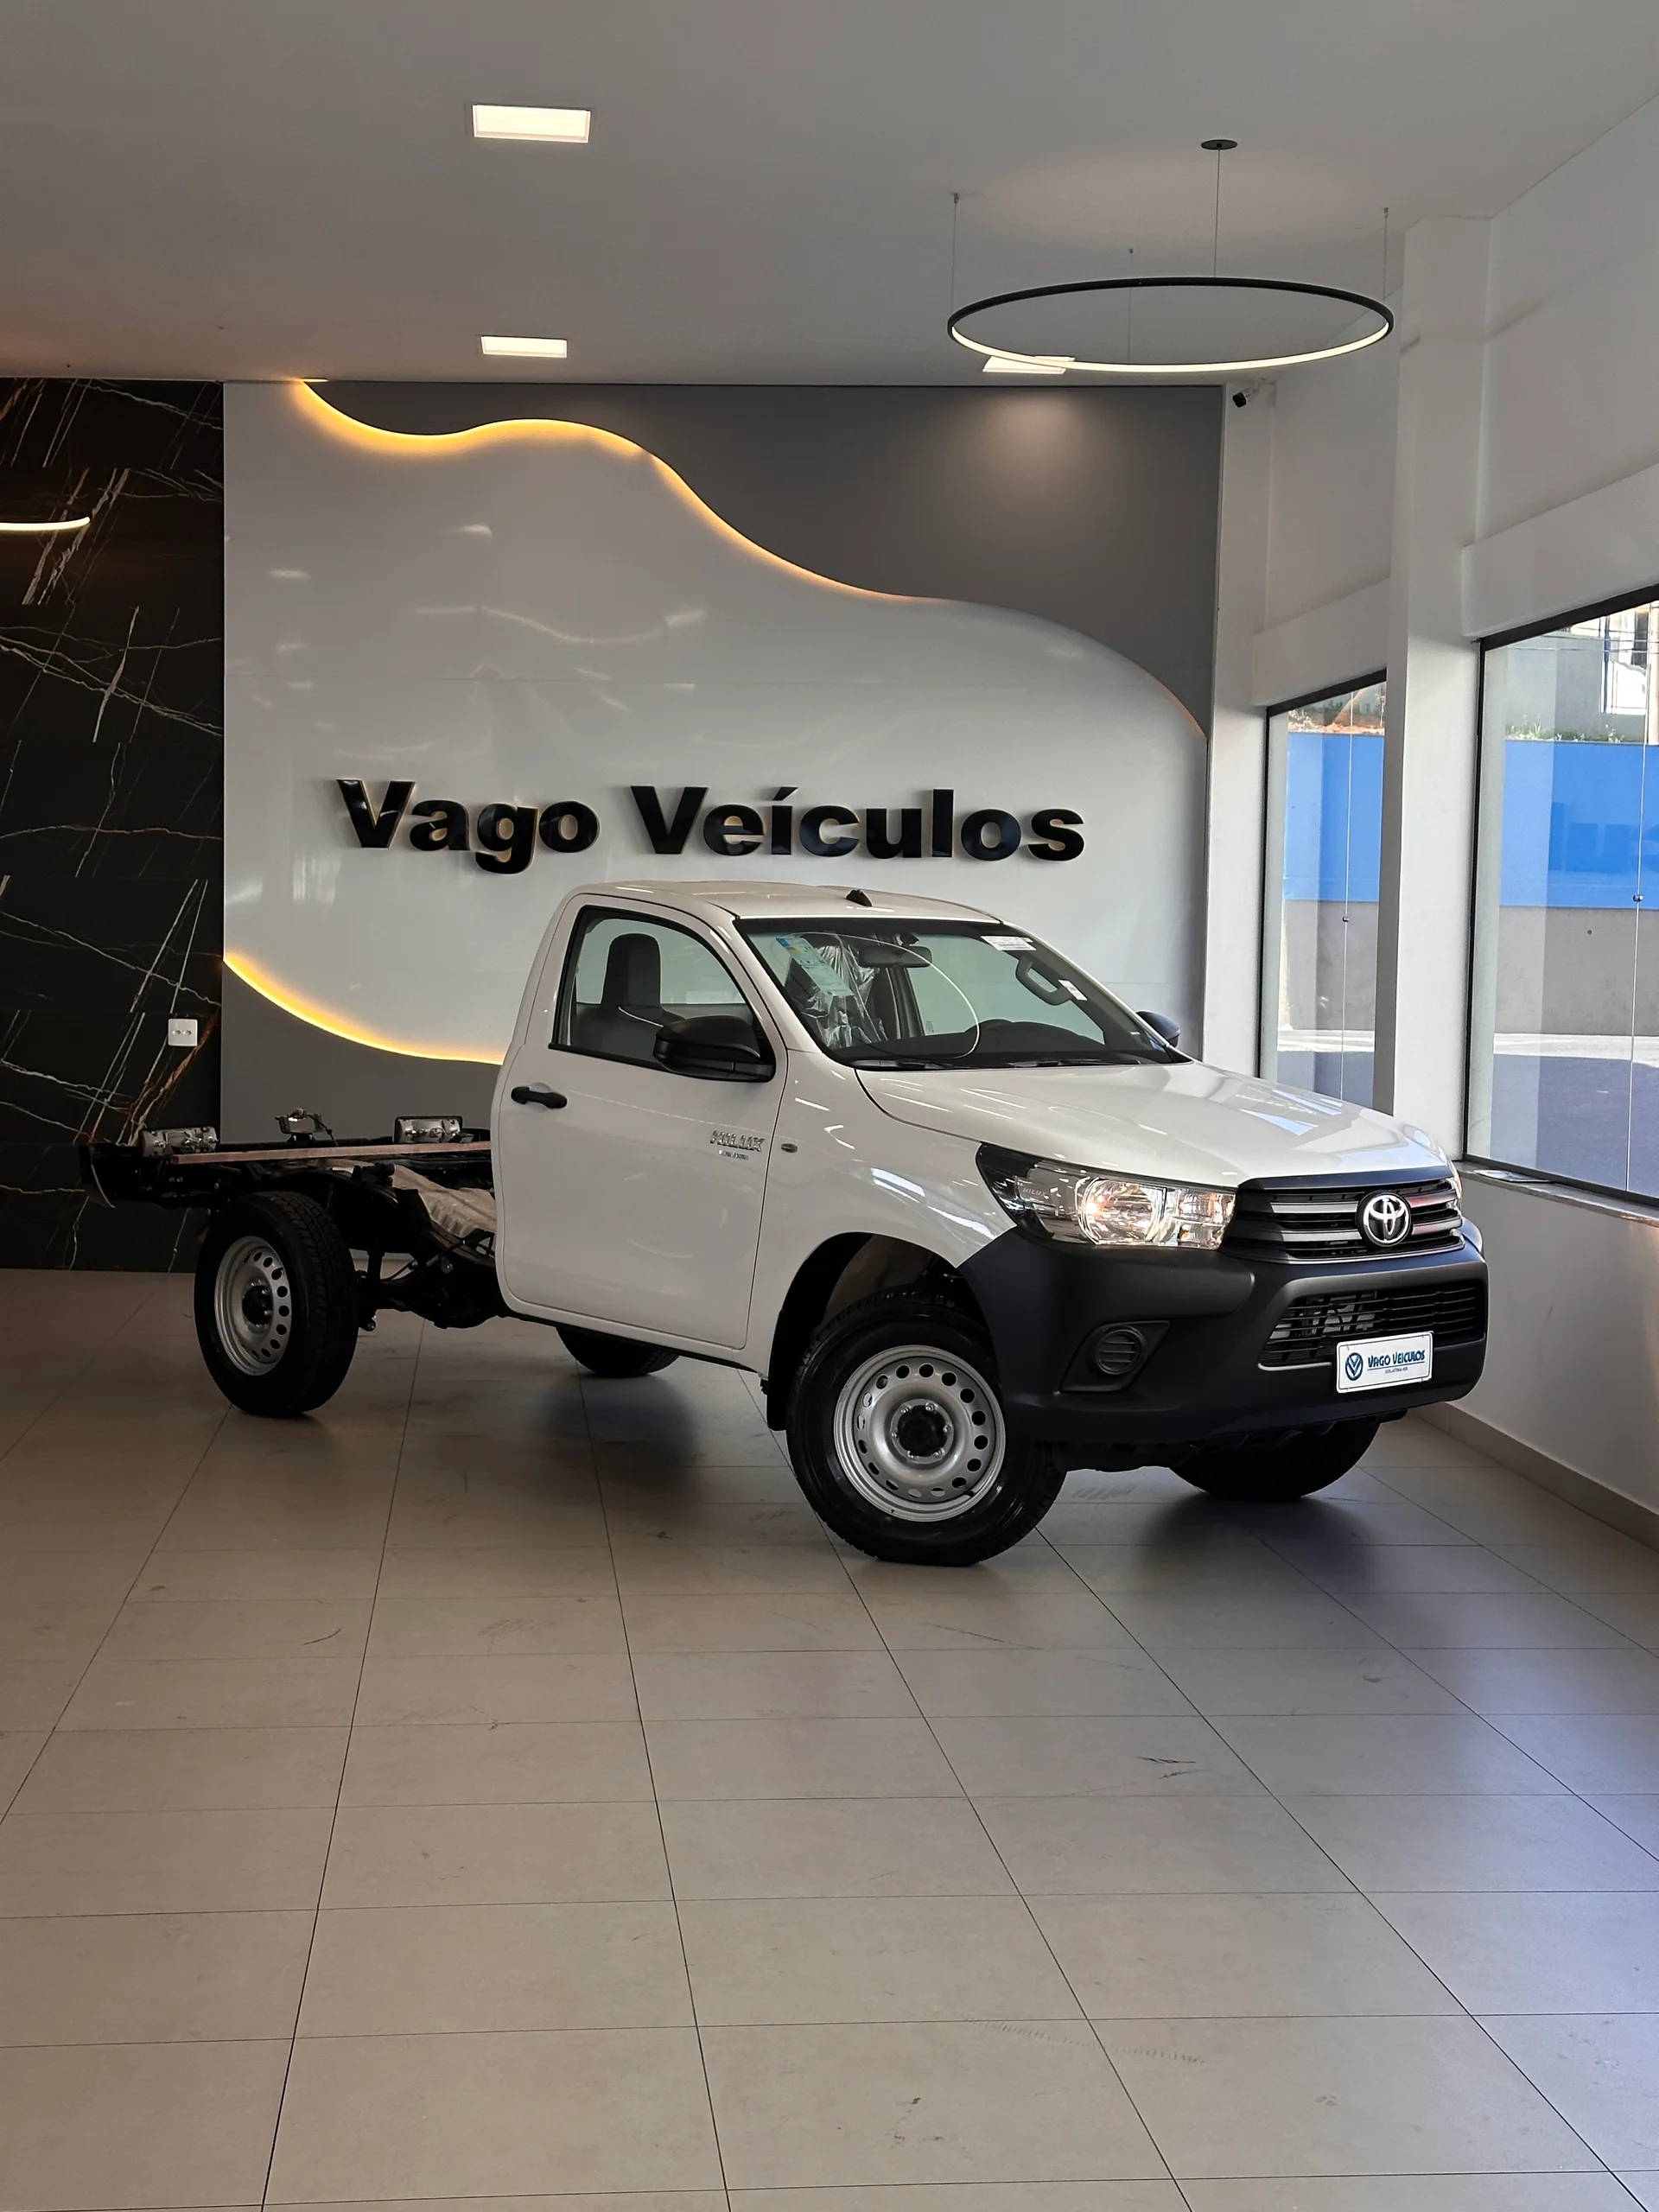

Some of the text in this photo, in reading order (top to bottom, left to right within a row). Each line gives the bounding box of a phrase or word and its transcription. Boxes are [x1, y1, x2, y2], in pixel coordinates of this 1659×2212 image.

[336, 779, 1085, 874] Vago Veículos
[1368, 1349, 1426, 1368] VAGO VEICULOS
